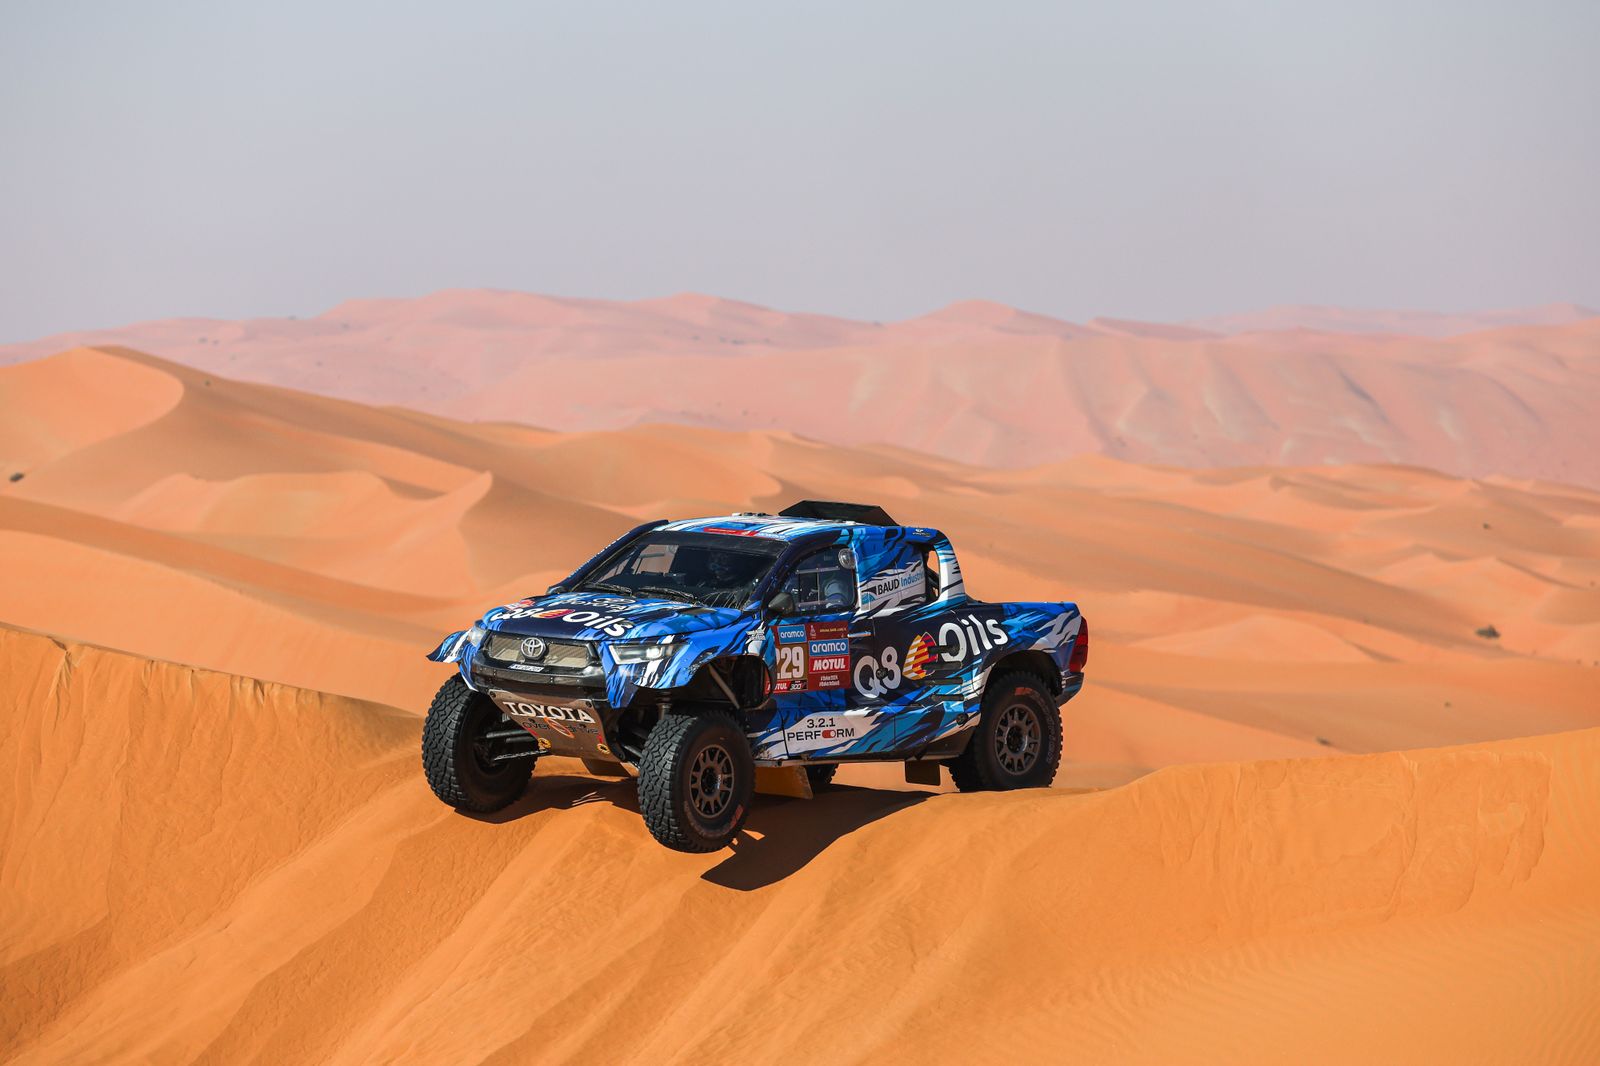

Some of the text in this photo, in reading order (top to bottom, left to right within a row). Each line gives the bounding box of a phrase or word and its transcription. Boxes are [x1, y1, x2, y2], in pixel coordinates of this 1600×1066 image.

[877, 578, 900, 595] BAUD
[562, 611, 634, 637] Oils
[780, 630, 805, 639] aramco
[811, 641, 847, 653] aramco
[812, 657, 846, 671] MOTUL
[854, 614, 1009, 699] Q8 Oils
[502, 701, 596, 724] TOYOTA
[806, 717, 836, 729] 3.2.1
